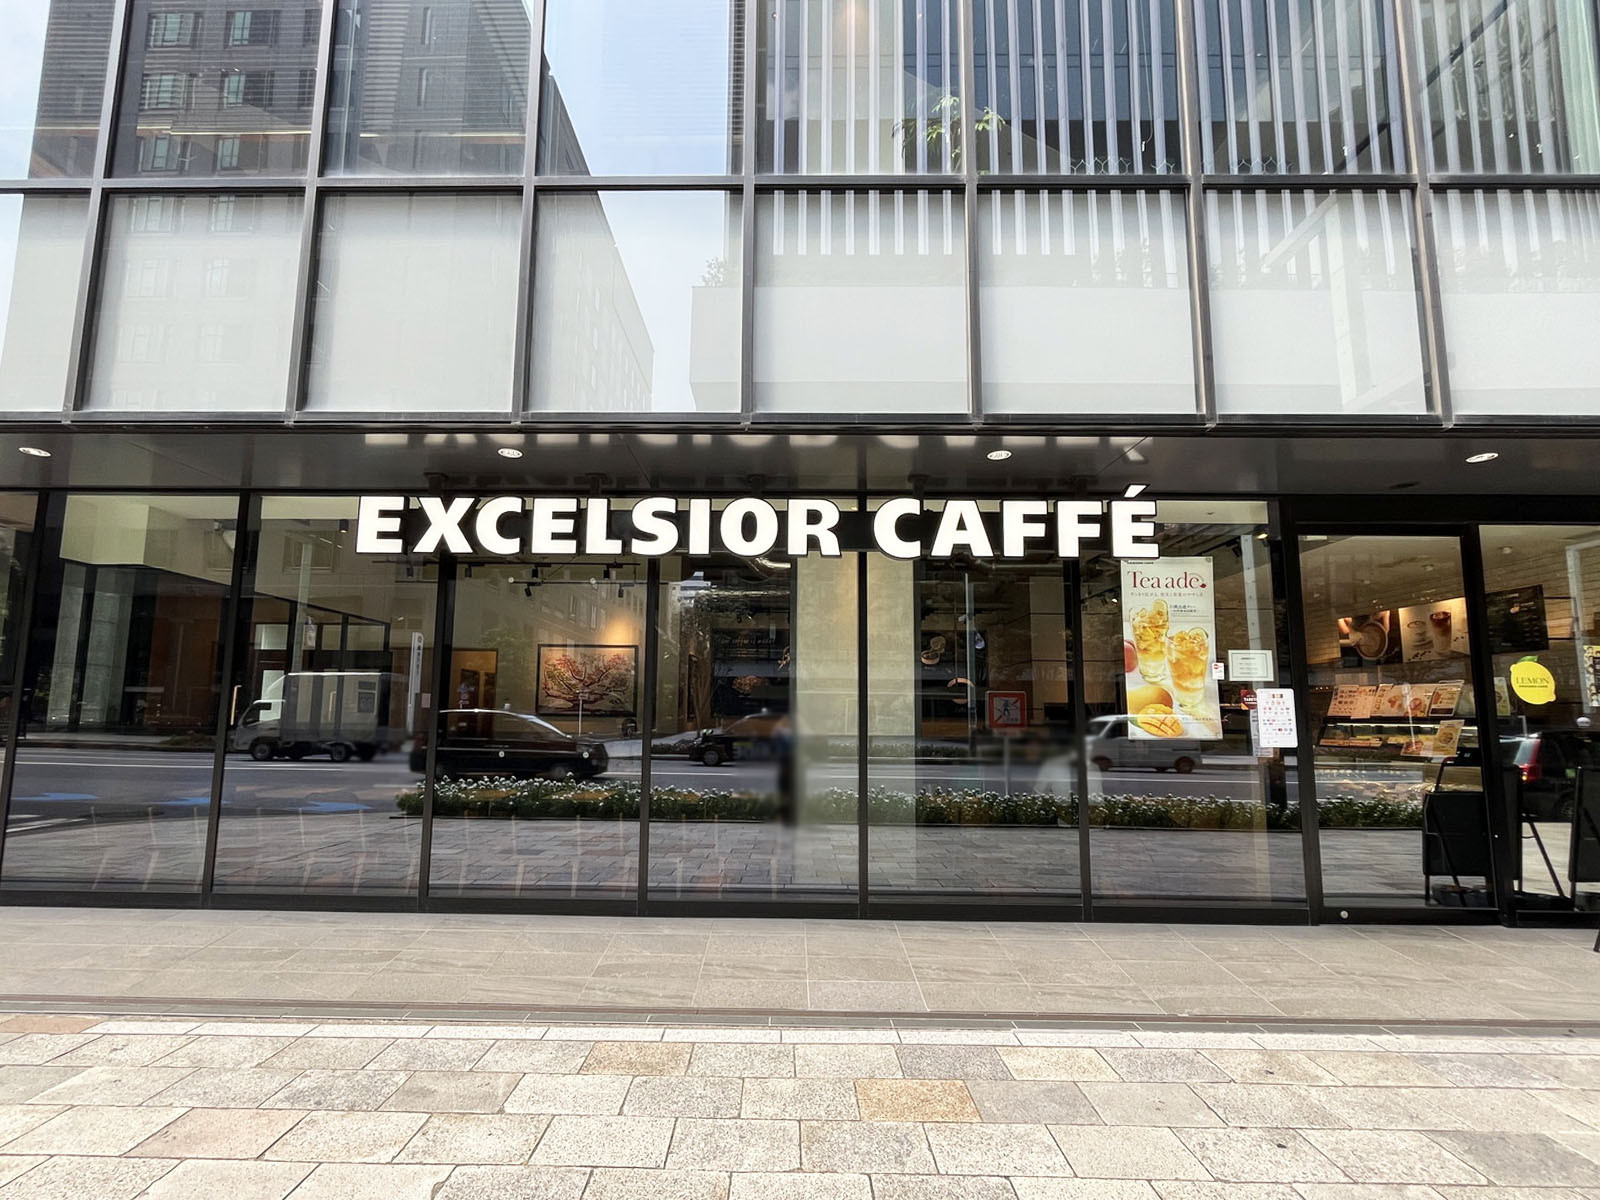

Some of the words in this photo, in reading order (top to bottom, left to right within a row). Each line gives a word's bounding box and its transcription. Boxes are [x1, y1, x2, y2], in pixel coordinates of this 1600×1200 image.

[356, 496, 841, 558] EXCELSIOR
[874, 485, 1160, 559] CAFFÉ
[1127, 571, 1161, 589] Tea
[1516, 677, 1550, 685] LEMON
